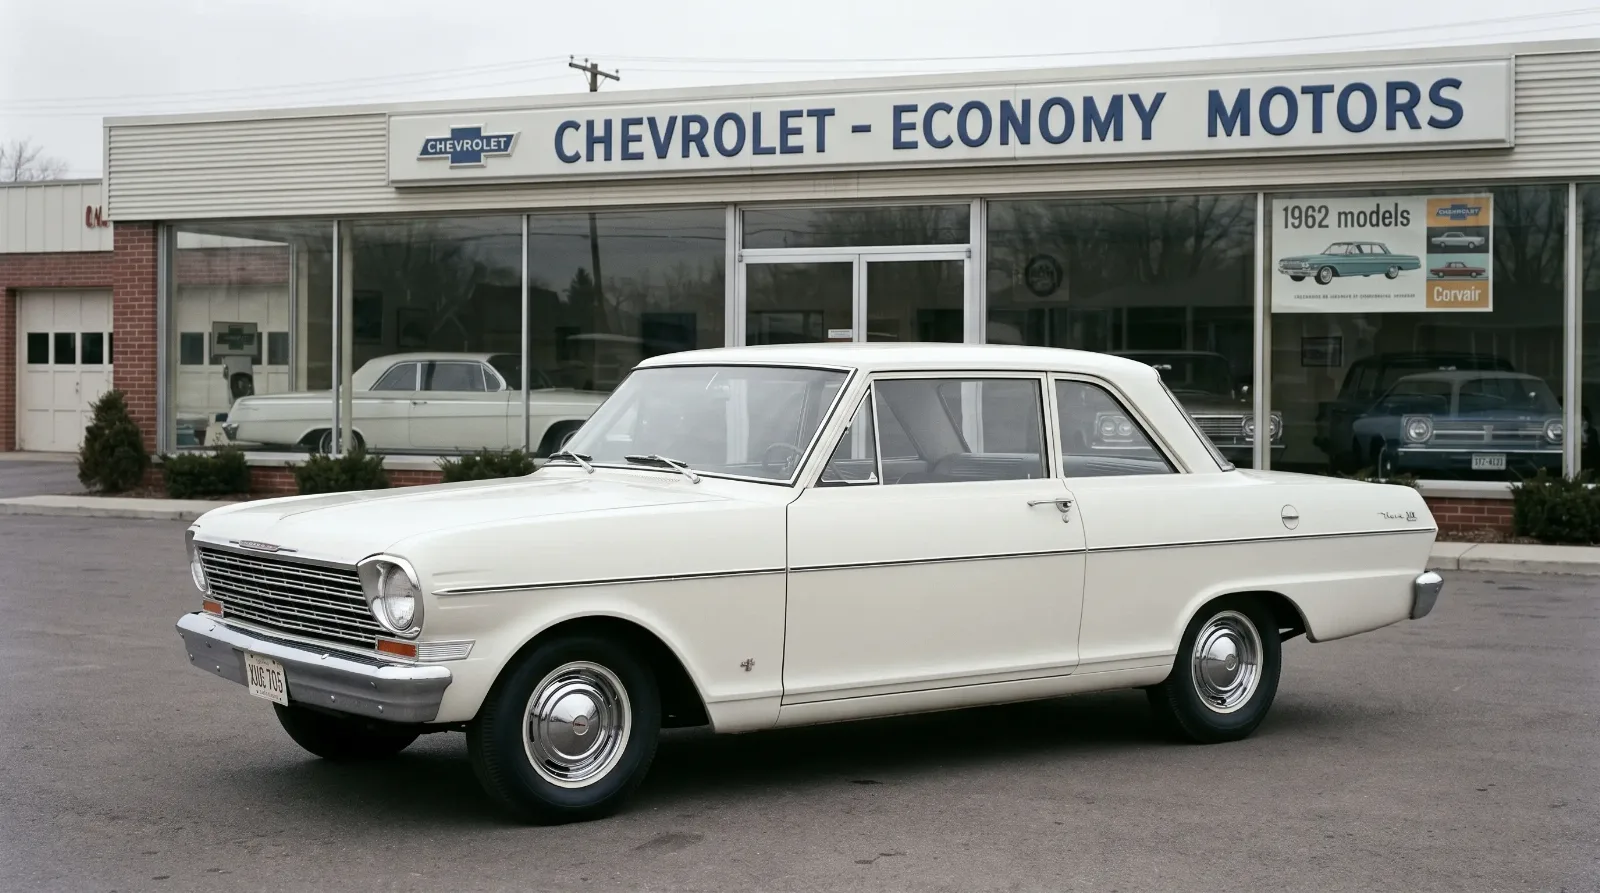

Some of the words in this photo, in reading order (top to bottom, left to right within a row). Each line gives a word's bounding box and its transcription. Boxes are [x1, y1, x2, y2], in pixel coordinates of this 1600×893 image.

[554, 107, 836, 164] CHEVROLET
[892, 91, 1167, 150] ECONOMY
[1207, 77, 1464, 138] MOTORS
[426, 136, 508, 153] CHEVROLET
[1282, 204, 1330, 229] 1962
[1337, 202, 1411, 229] models
[1433, 285, 1482, 302] Corvair
[266, 668, 283, 694] 705
